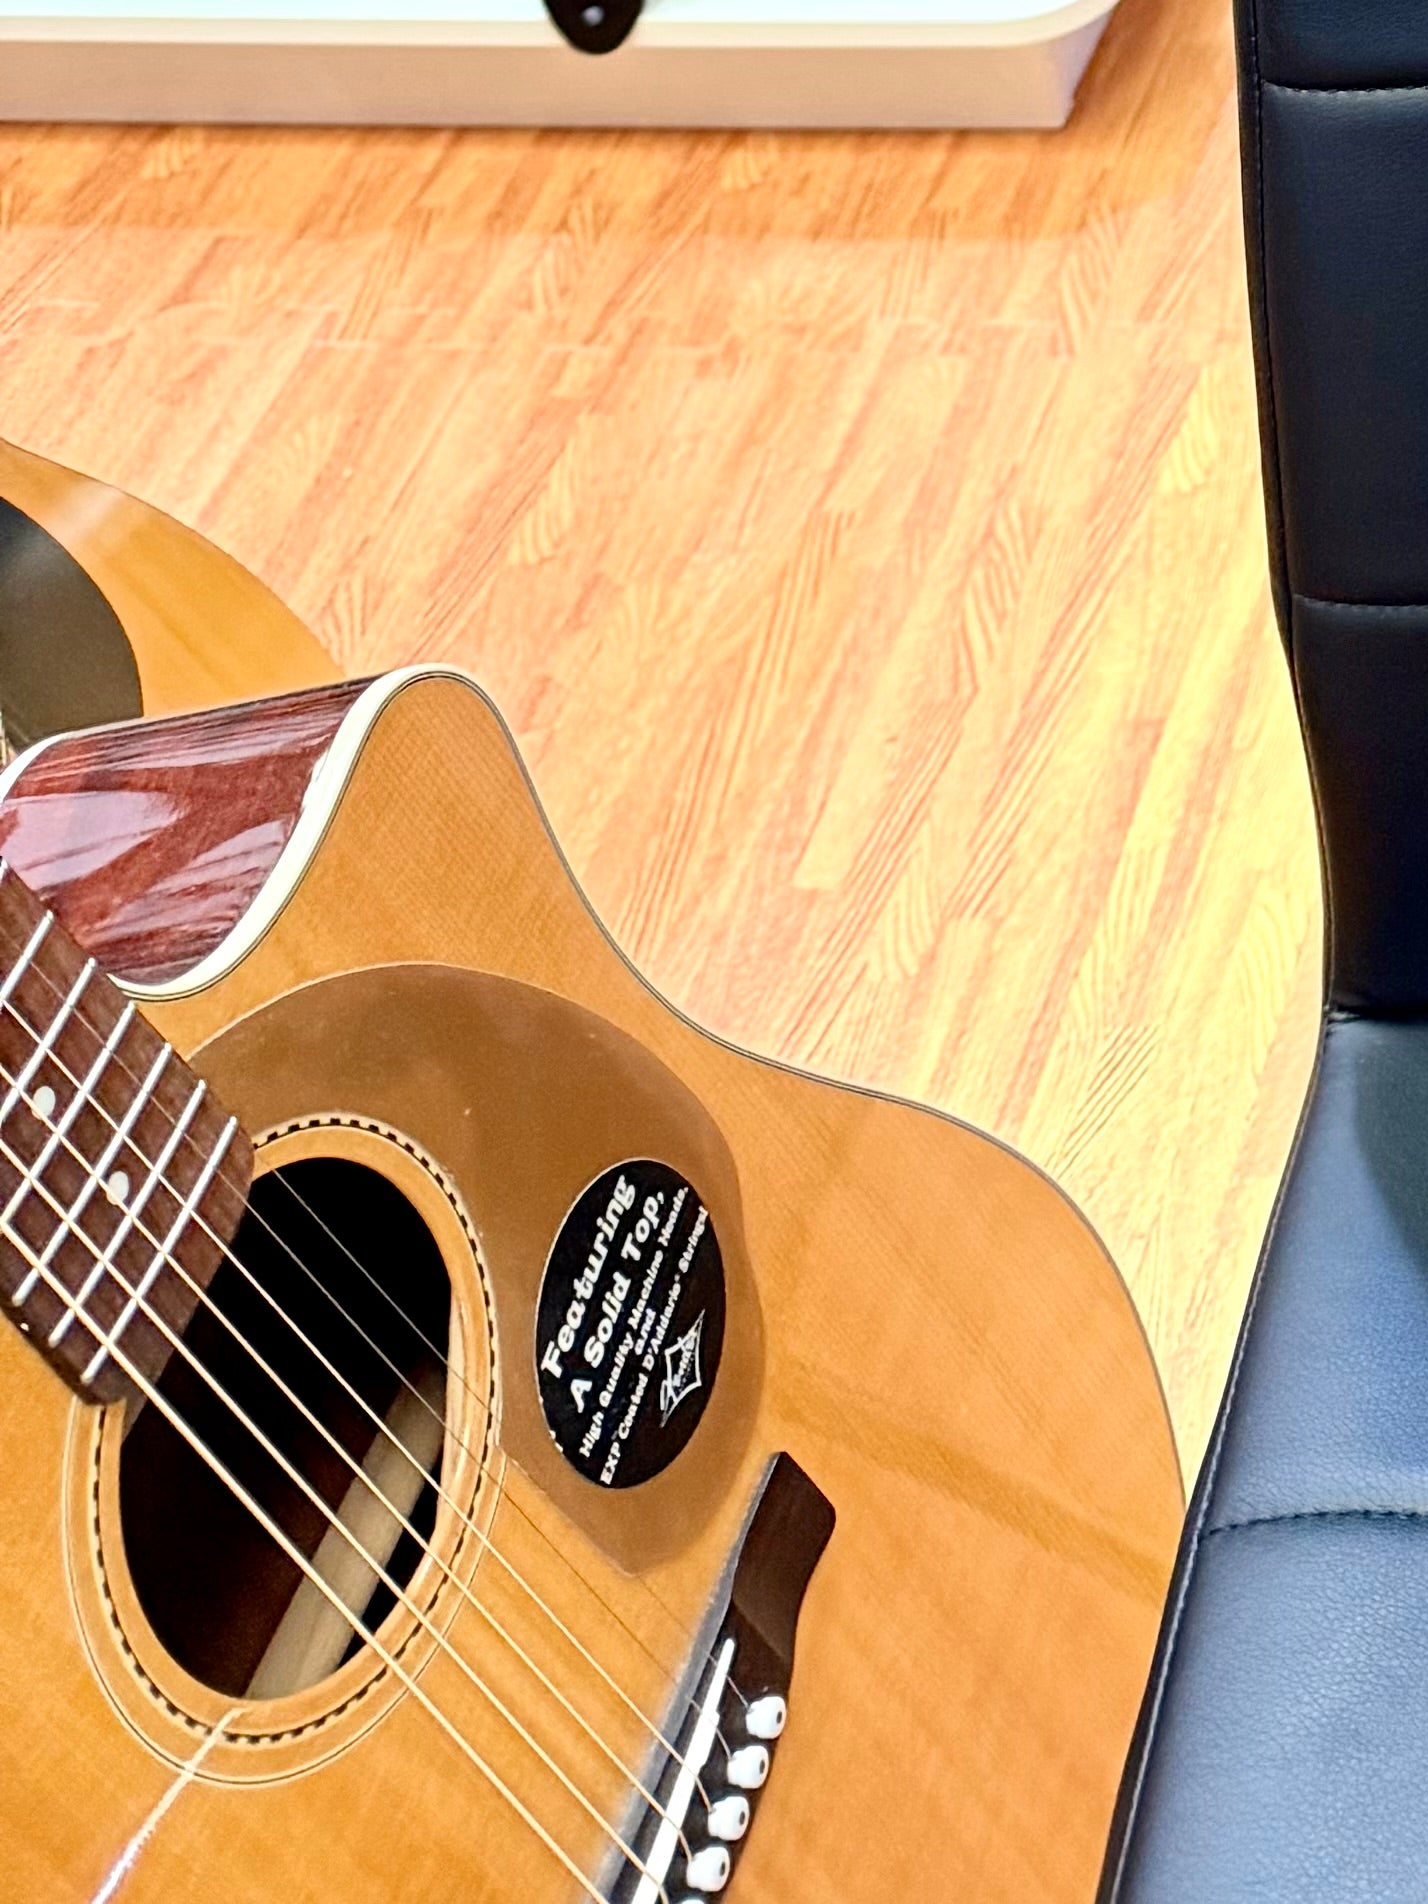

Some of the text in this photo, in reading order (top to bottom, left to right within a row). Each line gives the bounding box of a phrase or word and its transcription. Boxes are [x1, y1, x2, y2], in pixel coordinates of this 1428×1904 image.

[541, 1174, 636, 1379] Featuring
[570, 1191, 664, 1413] A Solid Top,
[579, 1412, 604, 1458] High
[599, 1331, 634, 1409] Quality
[627, 1250, 664, 1330] Machine
[634, 1307, 656, 1356] and
[617, 1372, 648, 1441] Coated
